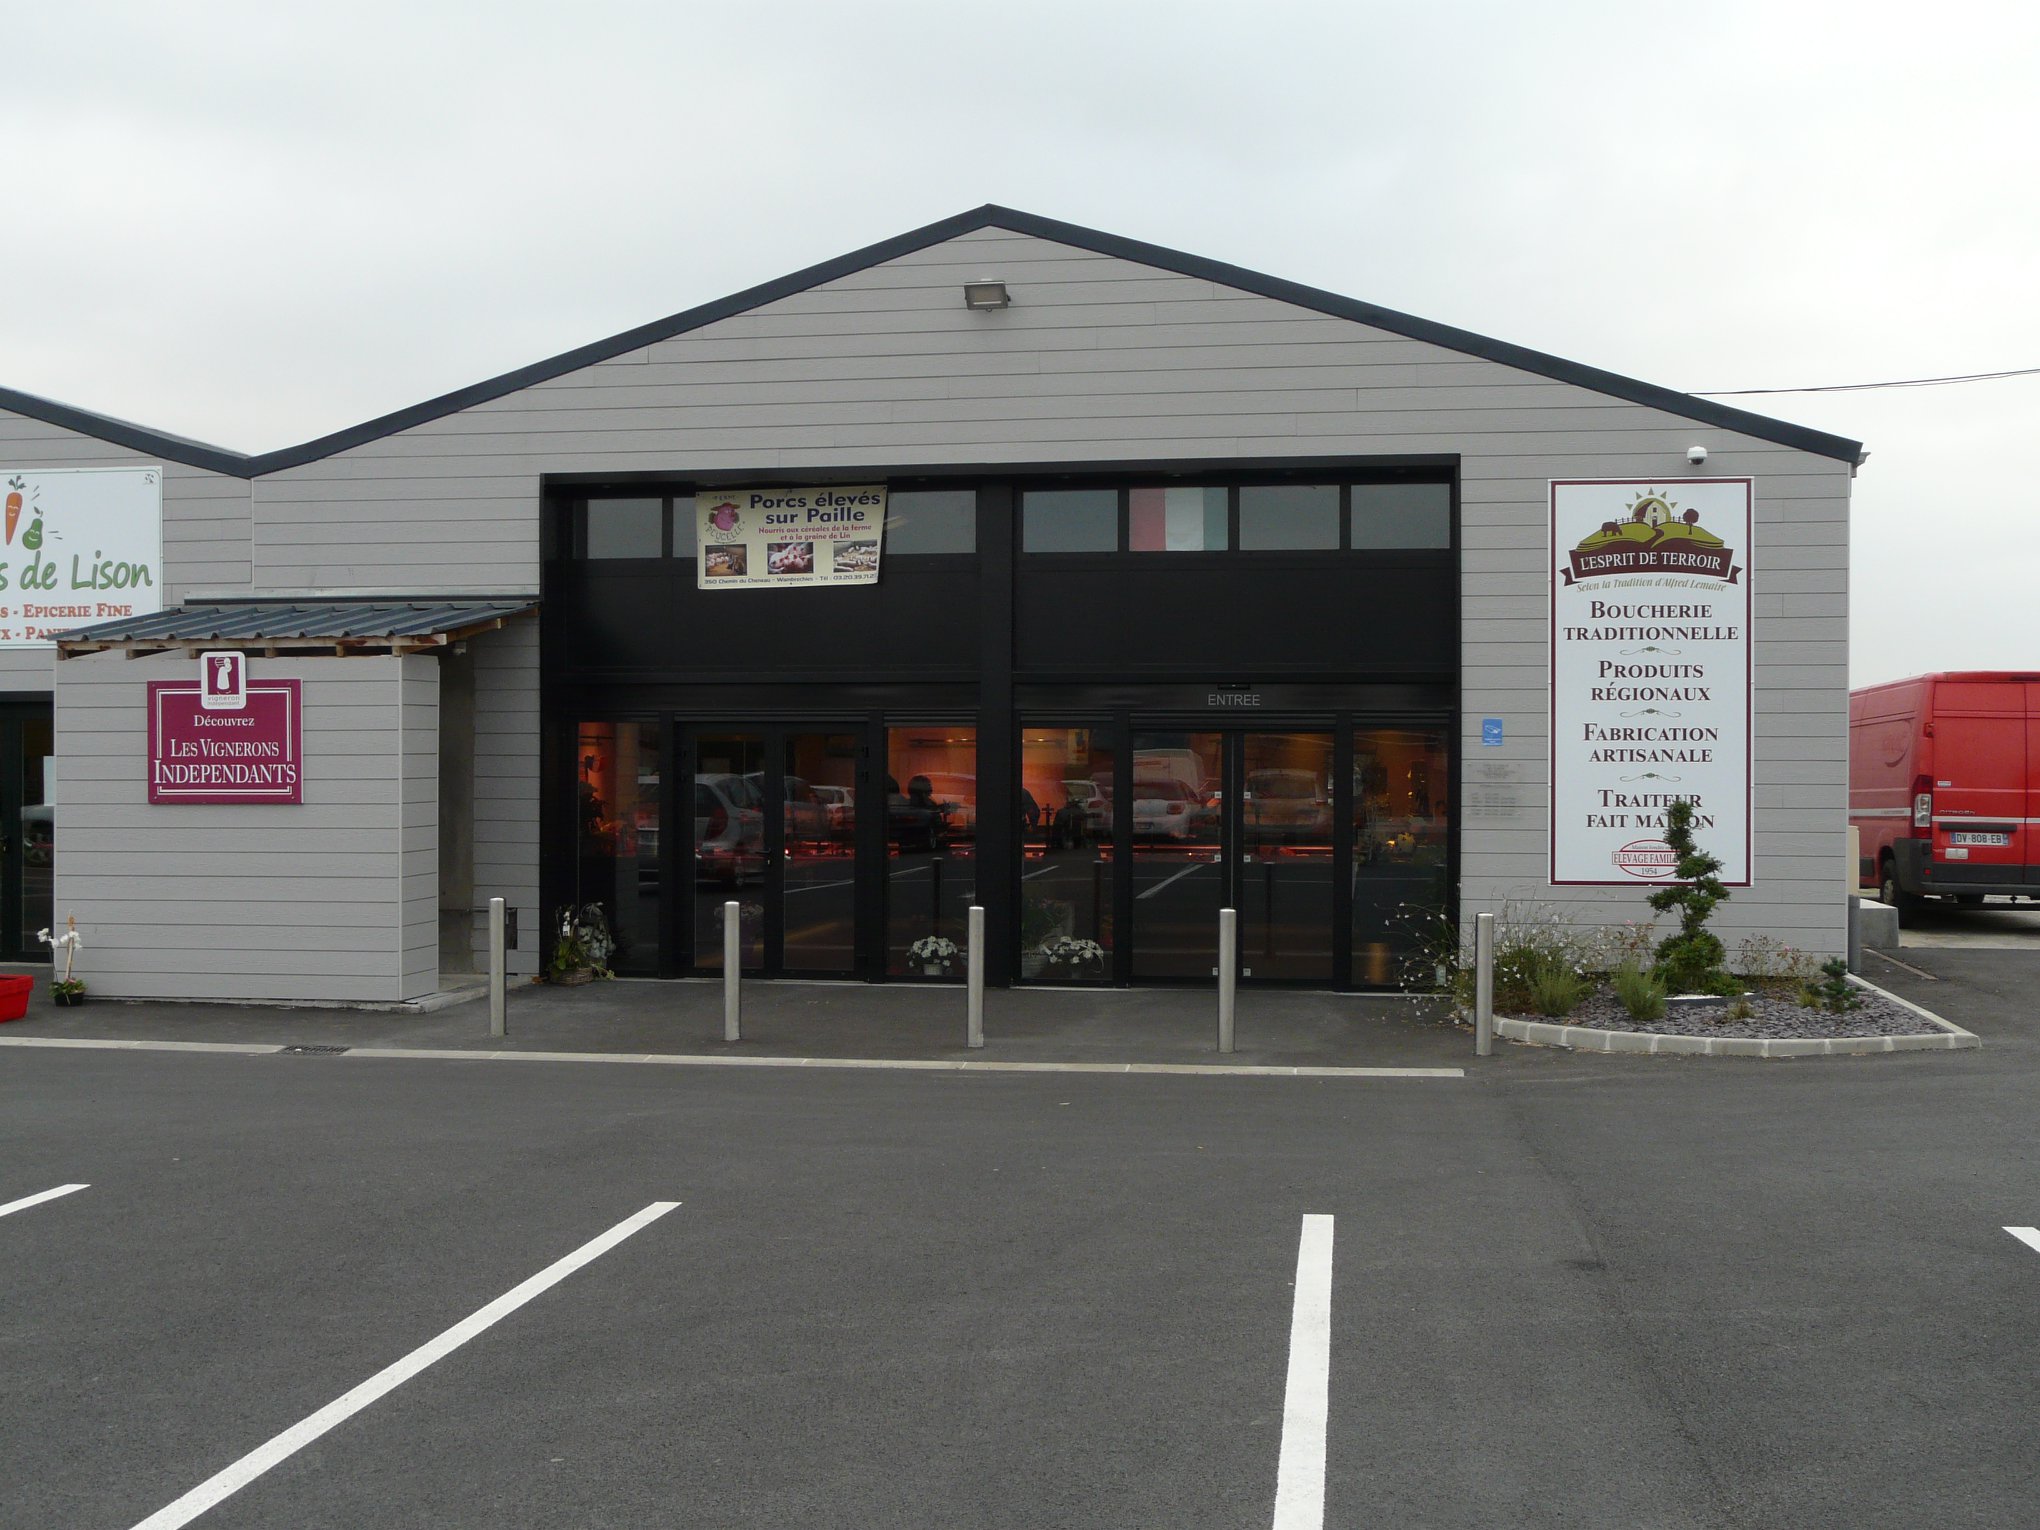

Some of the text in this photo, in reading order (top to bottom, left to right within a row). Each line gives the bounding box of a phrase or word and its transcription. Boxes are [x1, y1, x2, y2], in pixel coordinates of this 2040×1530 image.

[750, 490, 881, 509] Porcs élevés
[765, 506, 865, 524] sur Paille
[758, 526, 784, 534] Nourris
[800, 525, 830, 533] céréales
[831, 524, 840, 532] de
[842, 523, 850, 531] la
[851, 523, 872, 531] ferme
[795, 532, 803, 540] la
[804, 532, 826, 541] graine
[839, 531, 851, 539] Lin
[1580, 552, 1721, 571] L'ESPRIT DE TERROIR
[20, 550, 58, 590] de
[71, 550, 153, 590] Lison
[1576, 582, 1600, 593] Selon
[1601, 580, 1611, 589] la
[1613, 578, 1653, 588] Tradition
[1690, 578, 1727, 592] Lemaire
[23, 603, 92, 618] EPICERIE
[96, 602, 133, 617] FINE
[1591, 600, 1713, 619] BOUCHERIE
[1563, 626, 1739, 641] TRADITIONNELLE
[1599, 660, 1704, 679] PRODUITS
[1591, 681, 1711, 701] RÉGIONAUX
[1207, 694, 1261, 706] ENTREE
[193, 714, 255, 727] Découvrez
[1583, 723, 1719, 741] FABRICATION
[170, 738, 280, 757] LES VIGNERONS
[1589, 749, 1713, 763] ARTISANALE
[153, 759, 297, 784] INDEPENDANTS
[1586, 814, 1715, 829] FAIT MAION
[1613, 853, 1649, 864] ELEVAGE
[1641, 867, 1658, 875] 1954
